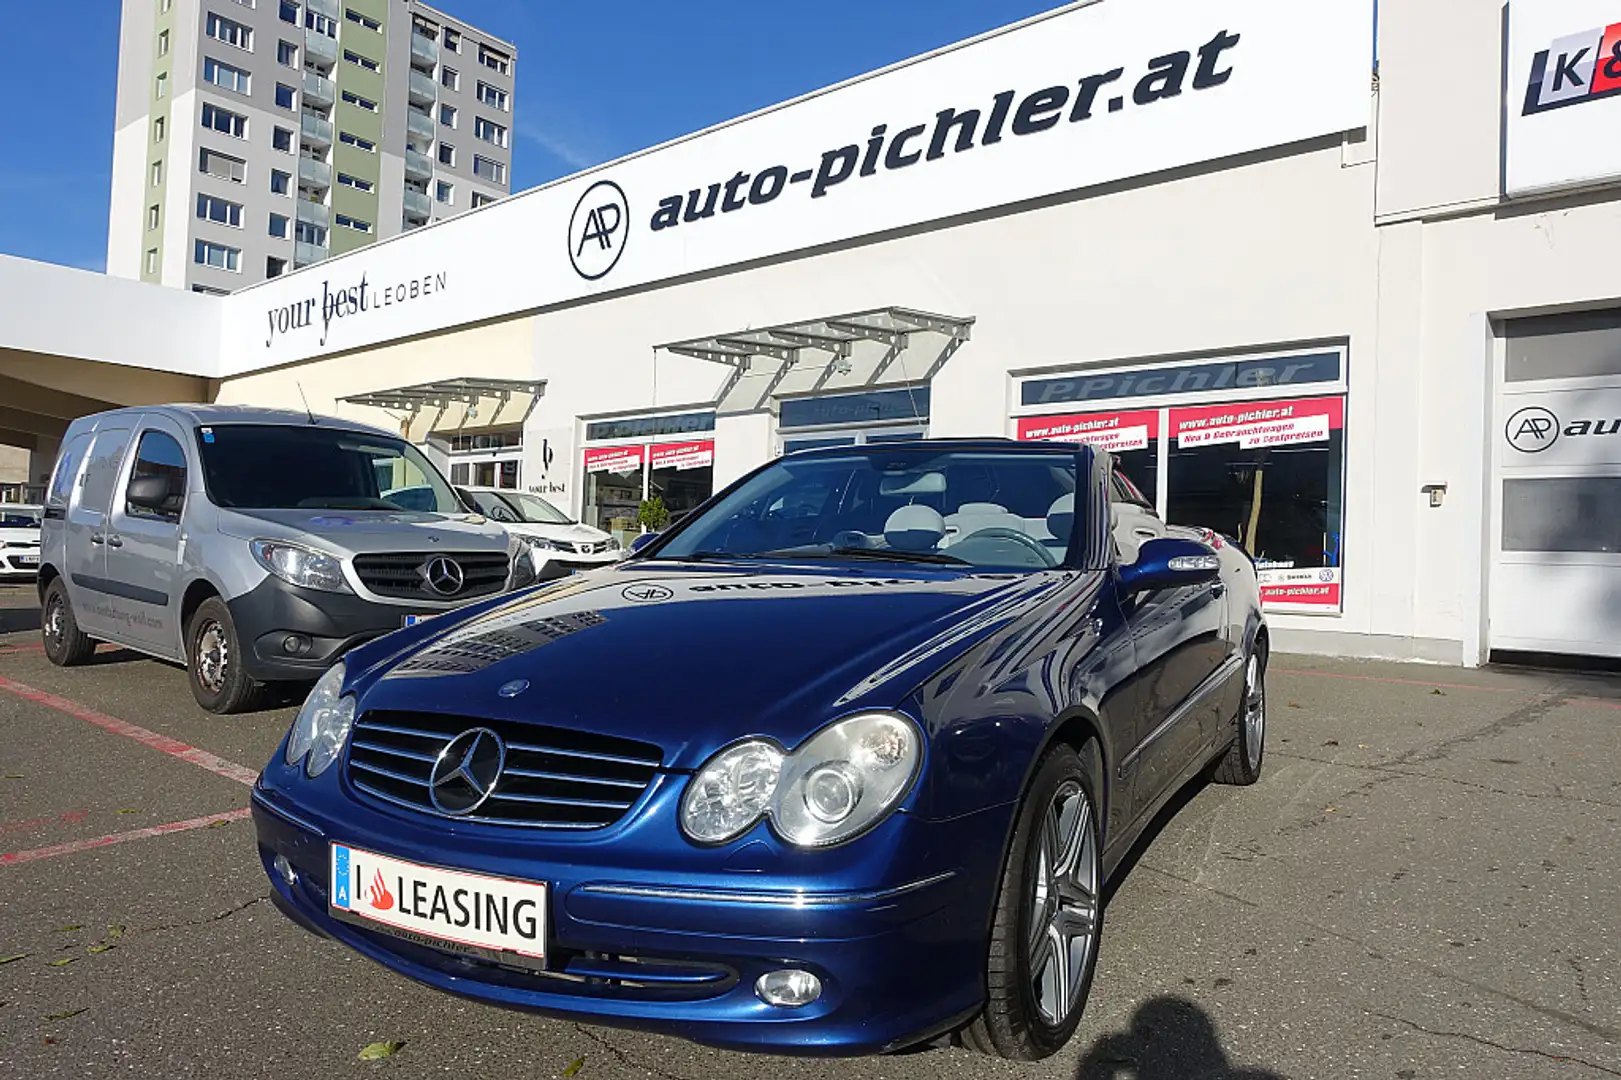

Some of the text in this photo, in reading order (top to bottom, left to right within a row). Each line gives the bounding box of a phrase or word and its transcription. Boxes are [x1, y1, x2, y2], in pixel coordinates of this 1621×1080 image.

[650, 28, 1241, 232] auto-pichler.at
[266, 270, 448, 347] your best LEOBEN
[1179, 405, 1295, 430] www.auto-pichler.at
[338, 885, 347, 901] A
[397, 875, 537, 940] LEASING
